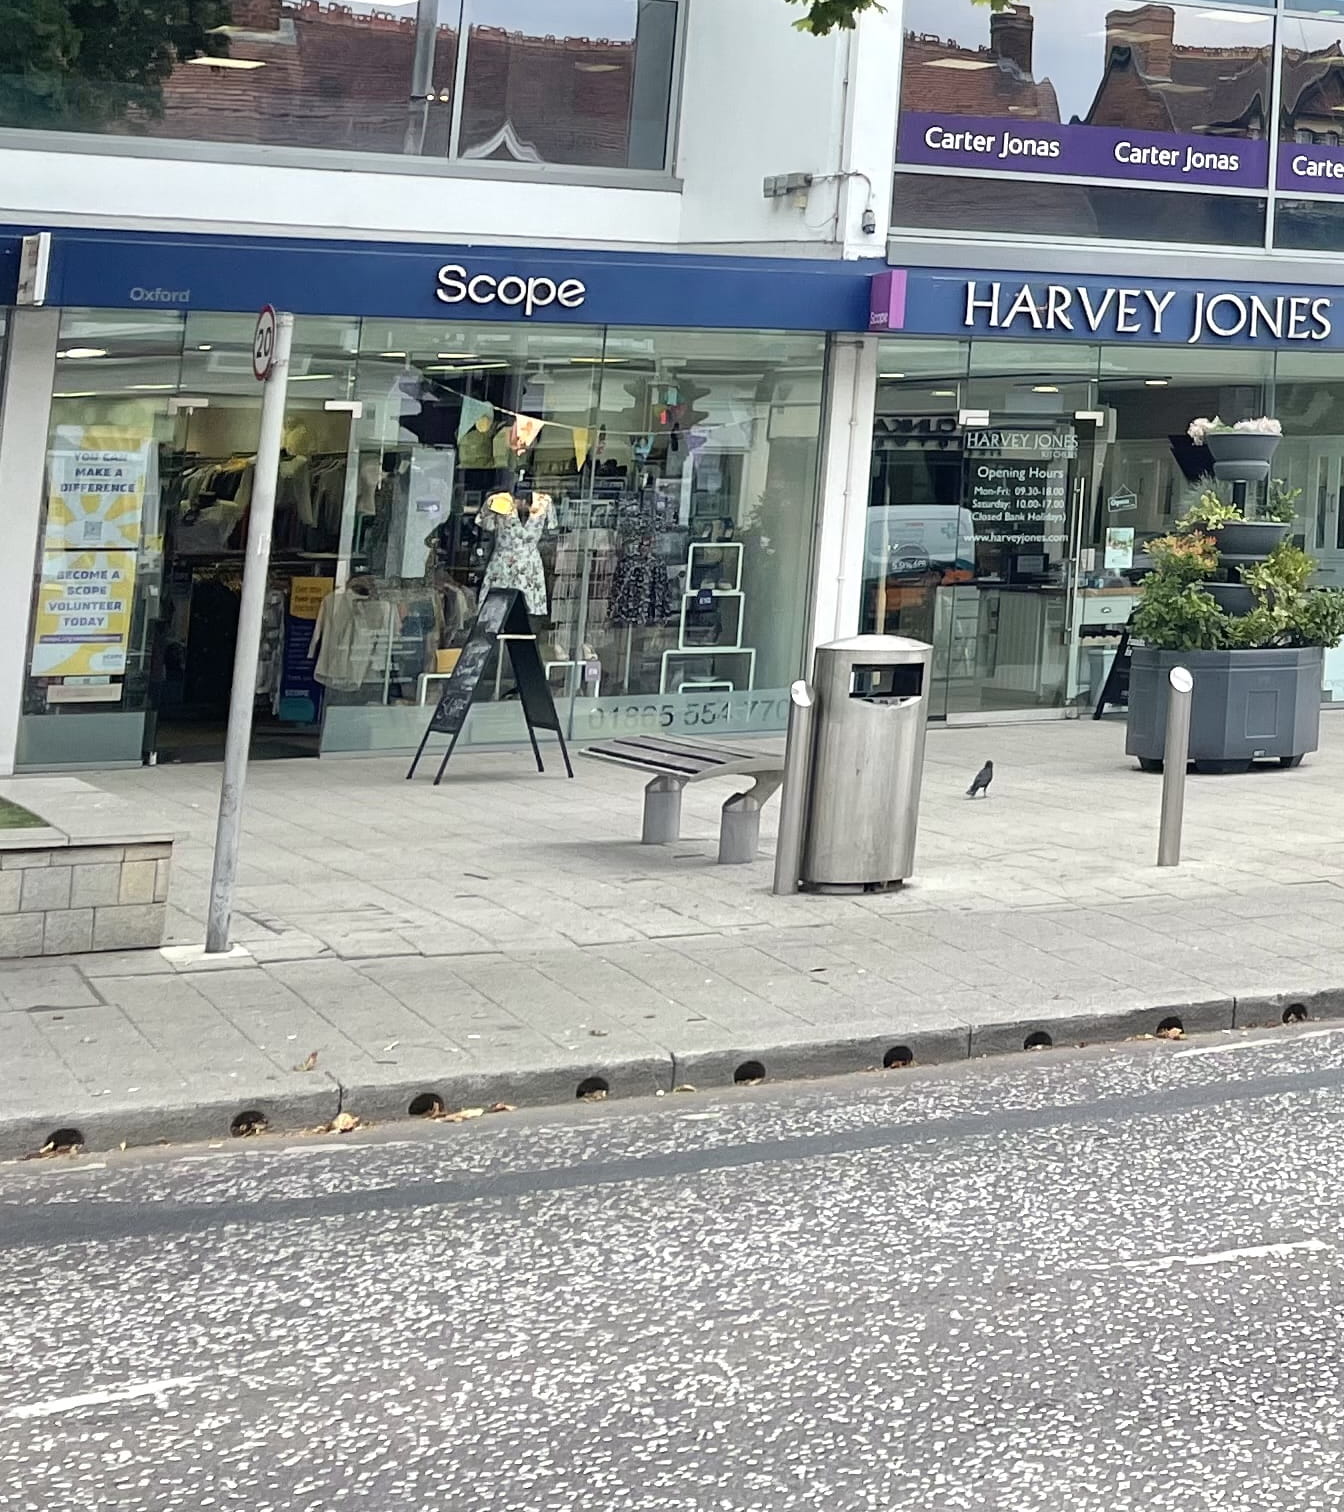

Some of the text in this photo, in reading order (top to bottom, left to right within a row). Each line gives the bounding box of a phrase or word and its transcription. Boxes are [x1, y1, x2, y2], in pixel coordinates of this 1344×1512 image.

[924, 126, 1061, 158] Carter Jonas
[1114, 141, 1240, 172] Carter Jonas
[130, 287, 190, 303] Oxford
[436, 264, 587, 316] Scope
[962, 280, 1176, 335] HARVEY
[1187, 292, 1332, 344] JONES
[256, 326, 273, 359] 20
[967, 432, 1079, 450] HARVEY JONES
[75, 468, 123, 477] MAKE A
[977, 466, 1065, 482] Opening Hours
[60, 483, 136, 493] DIFFERENCE
[968, 512, 1067, 523] (Closed Bank Holidays)
[963, 532, 1069, 545] www.harveyjones.com
[57, 570, 120, 580] BECOME A
[67, 585, 107, 596] SCOPE
[48, 601, 122, 611] VOLUNTEER
[64, 617, 105, 627] TODAY
